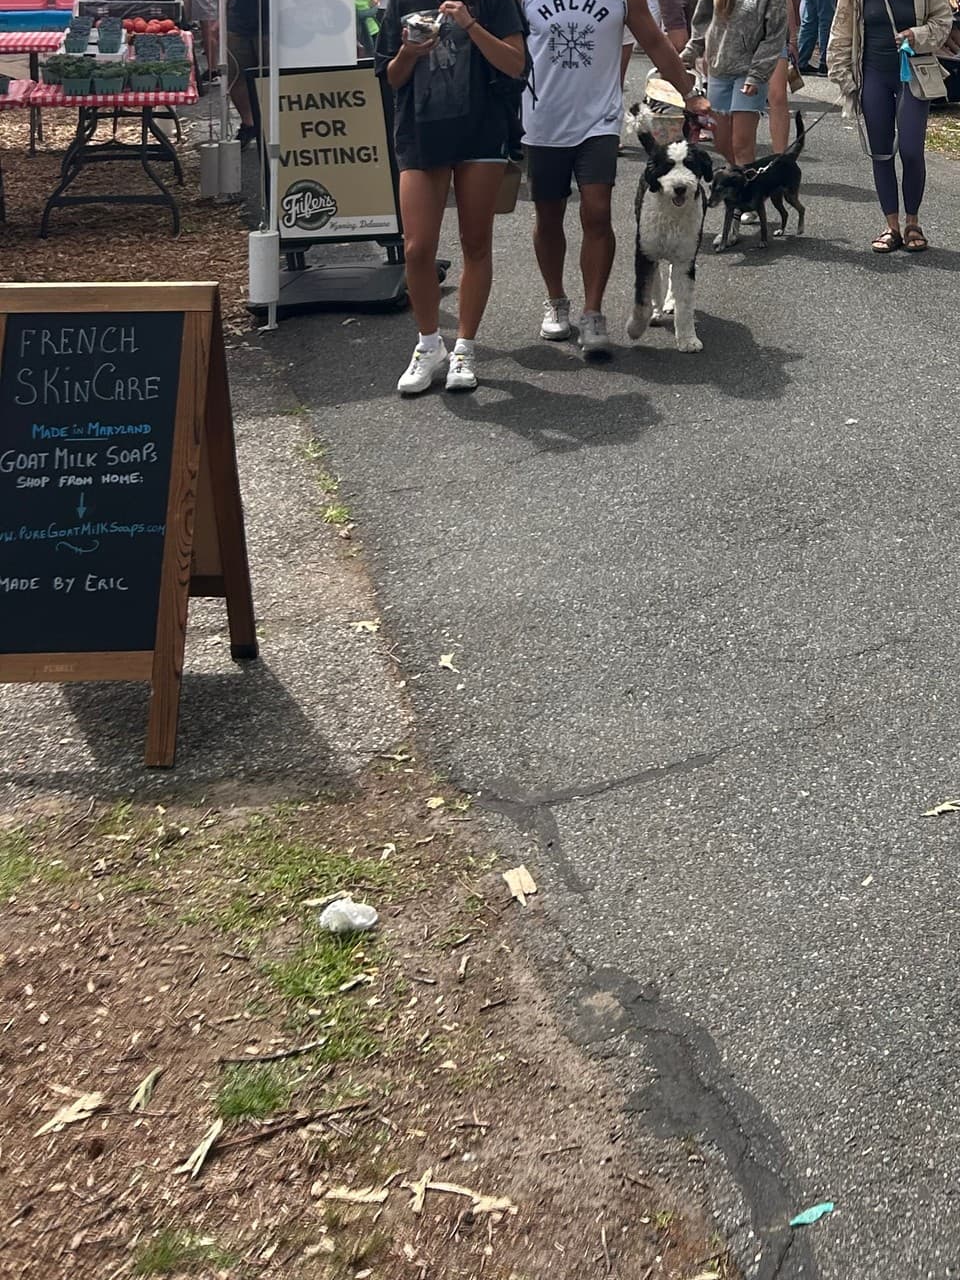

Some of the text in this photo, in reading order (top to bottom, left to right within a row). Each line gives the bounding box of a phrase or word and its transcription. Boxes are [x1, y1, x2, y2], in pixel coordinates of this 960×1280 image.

[279, 90, 366, 112] THANKS
[300, 119, 348, 138] FOR
[279, 145, 379, 167] VISITING!
[20, 326, 140, 357] FRENCH
[32, 423, 69, 439] MADE
[87, 422, 151, 436] MARYLAND
[0, 450, 49, 472] GOAT
[54, 447, 98, 469] MILK
[16, 472, 144, 488] SHOP FROM HOME:
[0, 574, 129, 593] MADE BY ERIC
